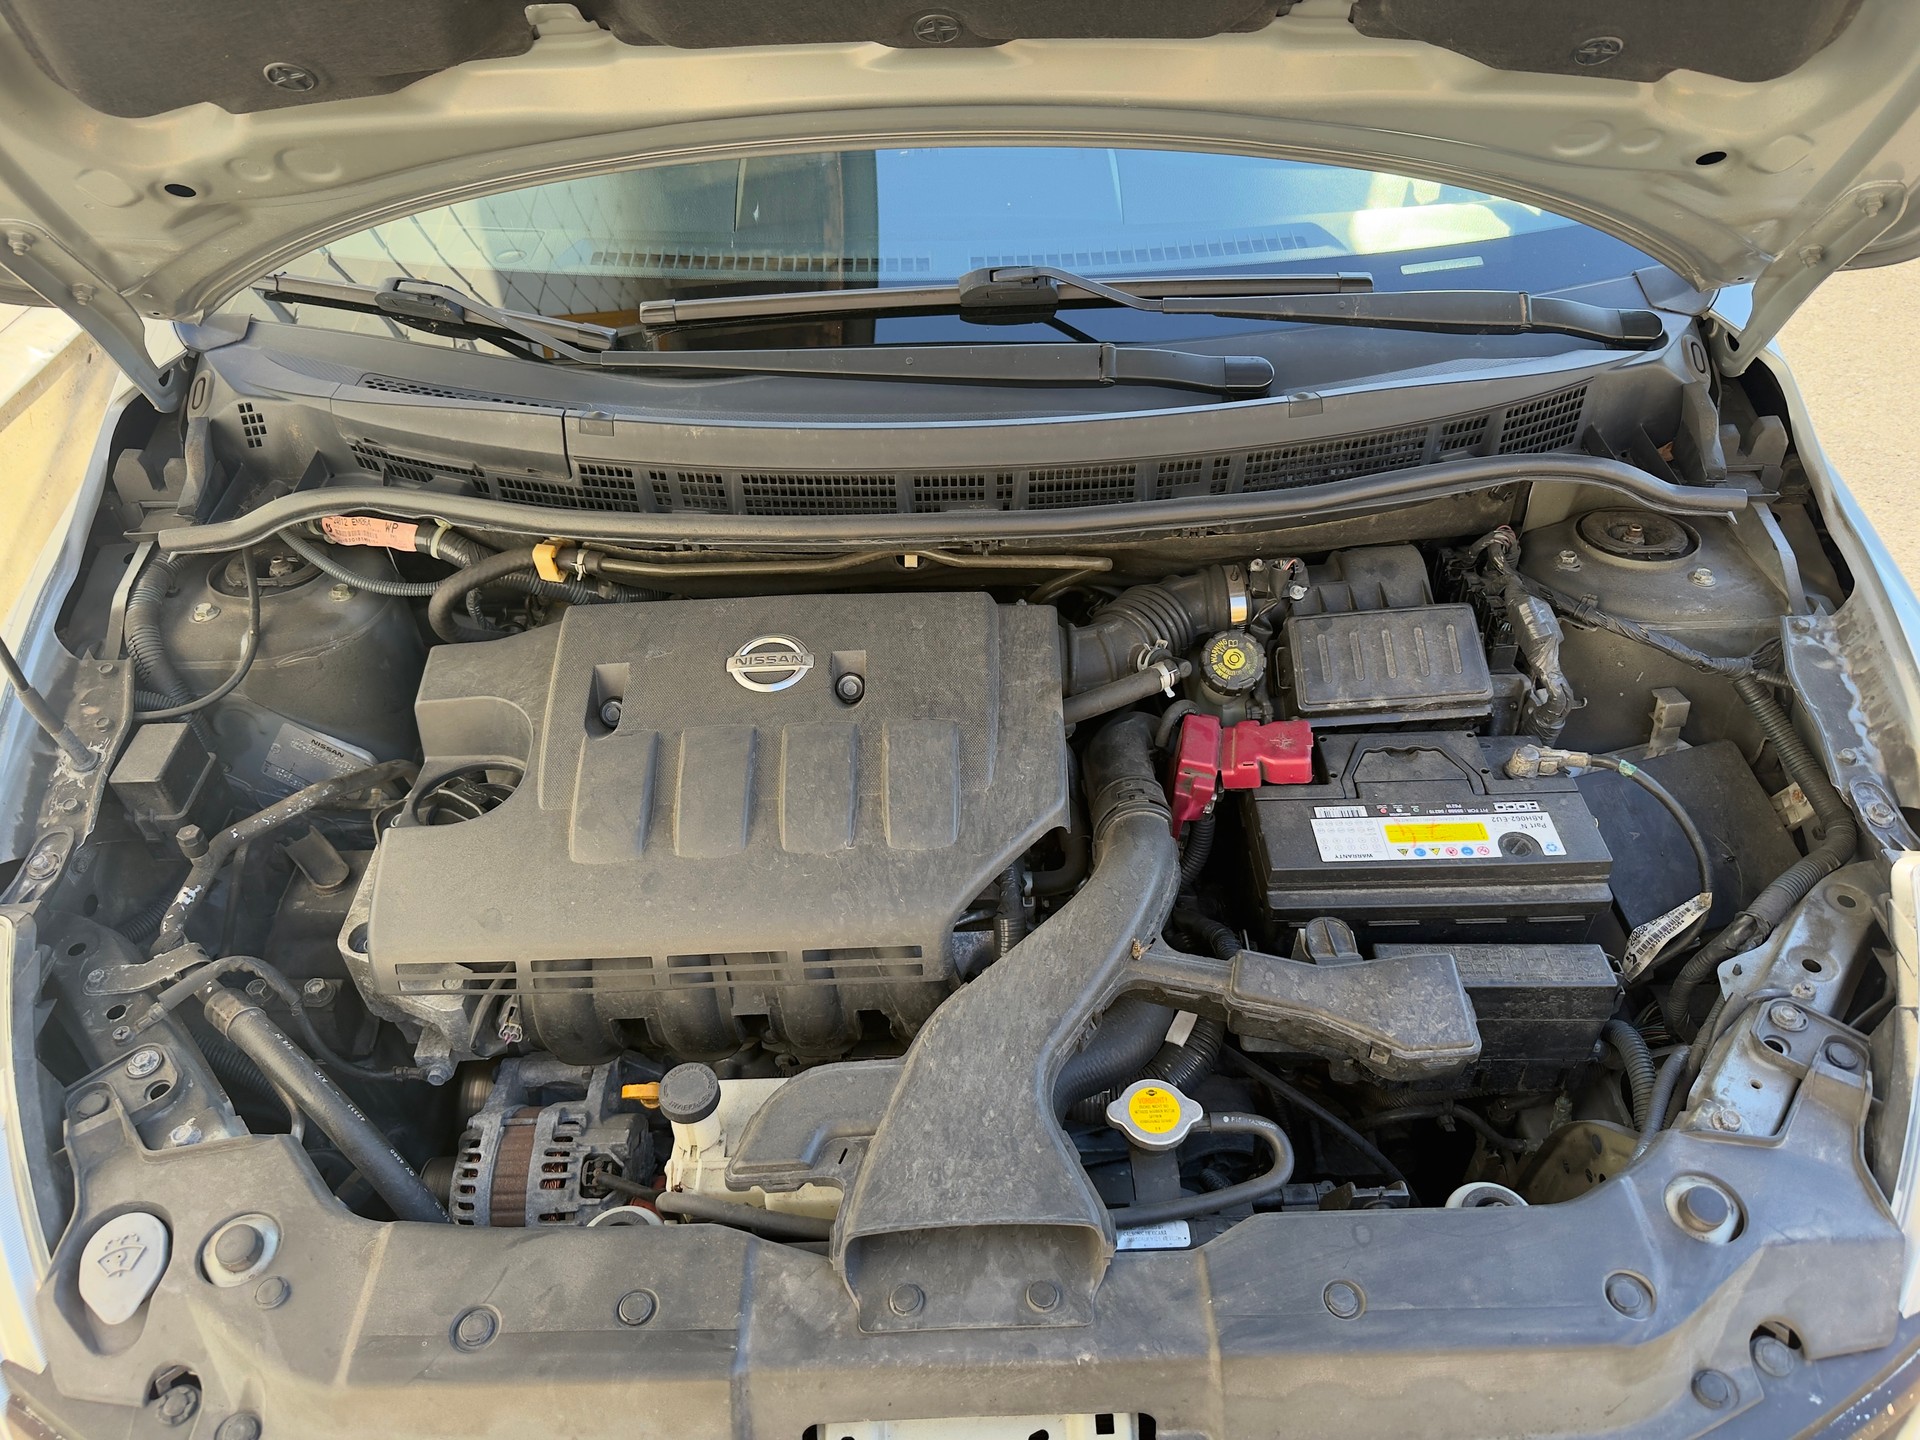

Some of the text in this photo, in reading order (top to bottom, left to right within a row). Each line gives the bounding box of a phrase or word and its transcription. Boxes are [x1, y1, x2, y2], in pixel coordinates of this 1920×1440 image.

[385, 521, 399, 534] WP
[1210, 638, 1228, 664] WARNING
[735, 655, 804, 666] NISSAN
[310, 738, 345, 758] NISSAN
[1529, 822, 1547, 830] Part
[1334, 852, 1374, 860] WARRANTY
[314, 1071, 329, 1083] A/C
